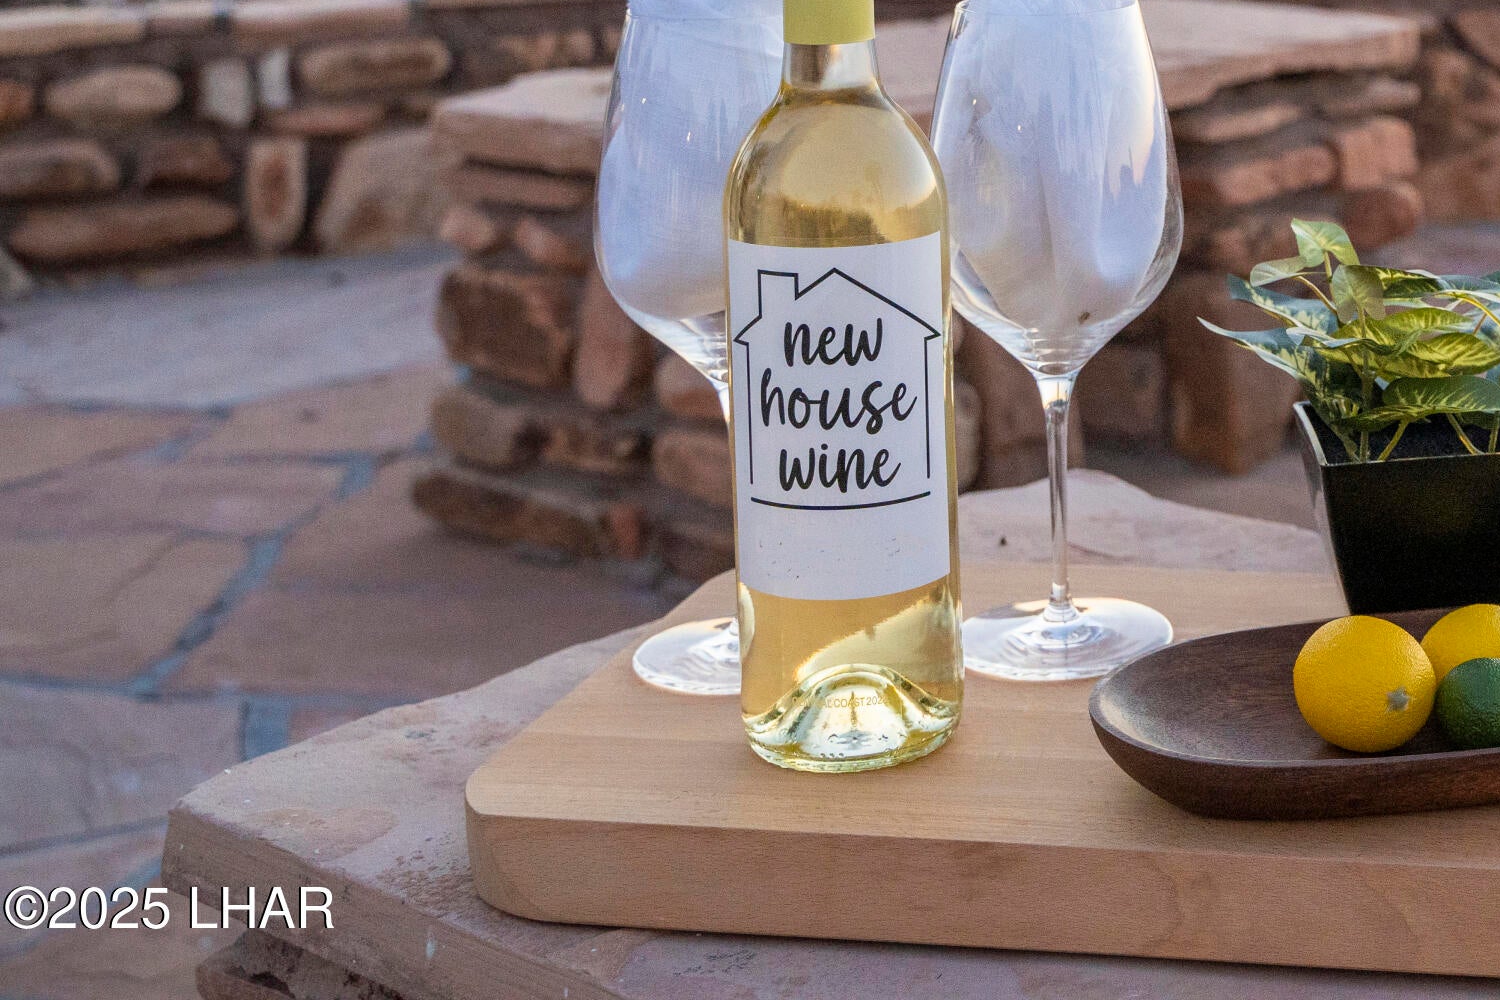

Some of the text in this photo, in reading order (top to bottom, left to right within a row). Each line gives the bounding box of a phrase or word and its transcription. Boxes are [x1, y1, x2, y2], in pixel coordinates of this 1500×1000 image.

[784, 318, 882, 367] new
[761, 368, 917, 435] house
[779, 444, 901, 493] wine
